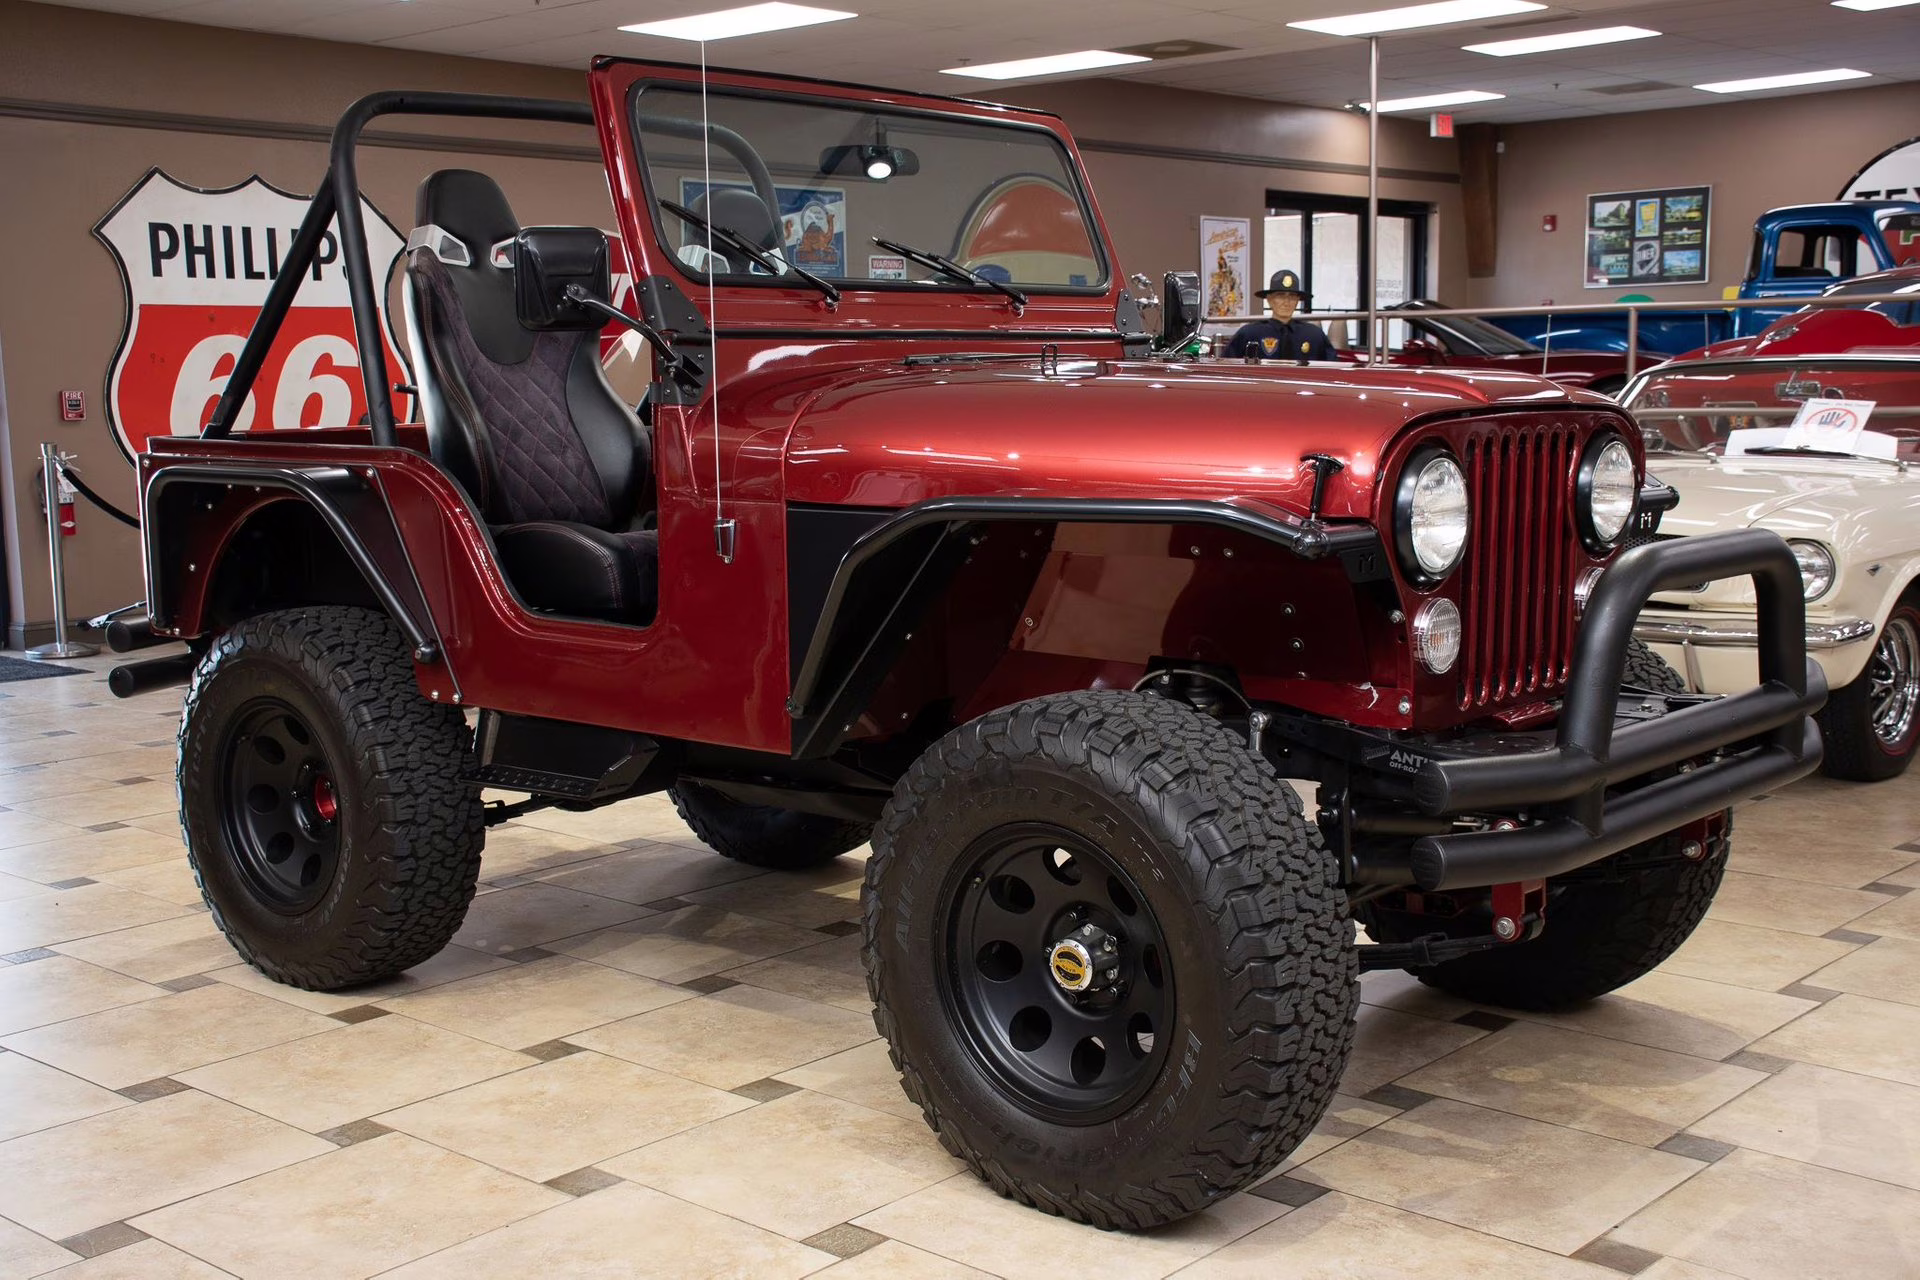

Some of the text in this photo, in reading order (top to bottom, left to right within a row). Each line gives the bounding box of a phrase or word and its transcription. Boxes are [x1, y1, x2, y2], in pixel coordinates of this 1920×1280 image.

[148, 222, 350, 282] PHILLP
[872, 259, 903, 269] WARNING
[170, 334, 361, 438] 66
